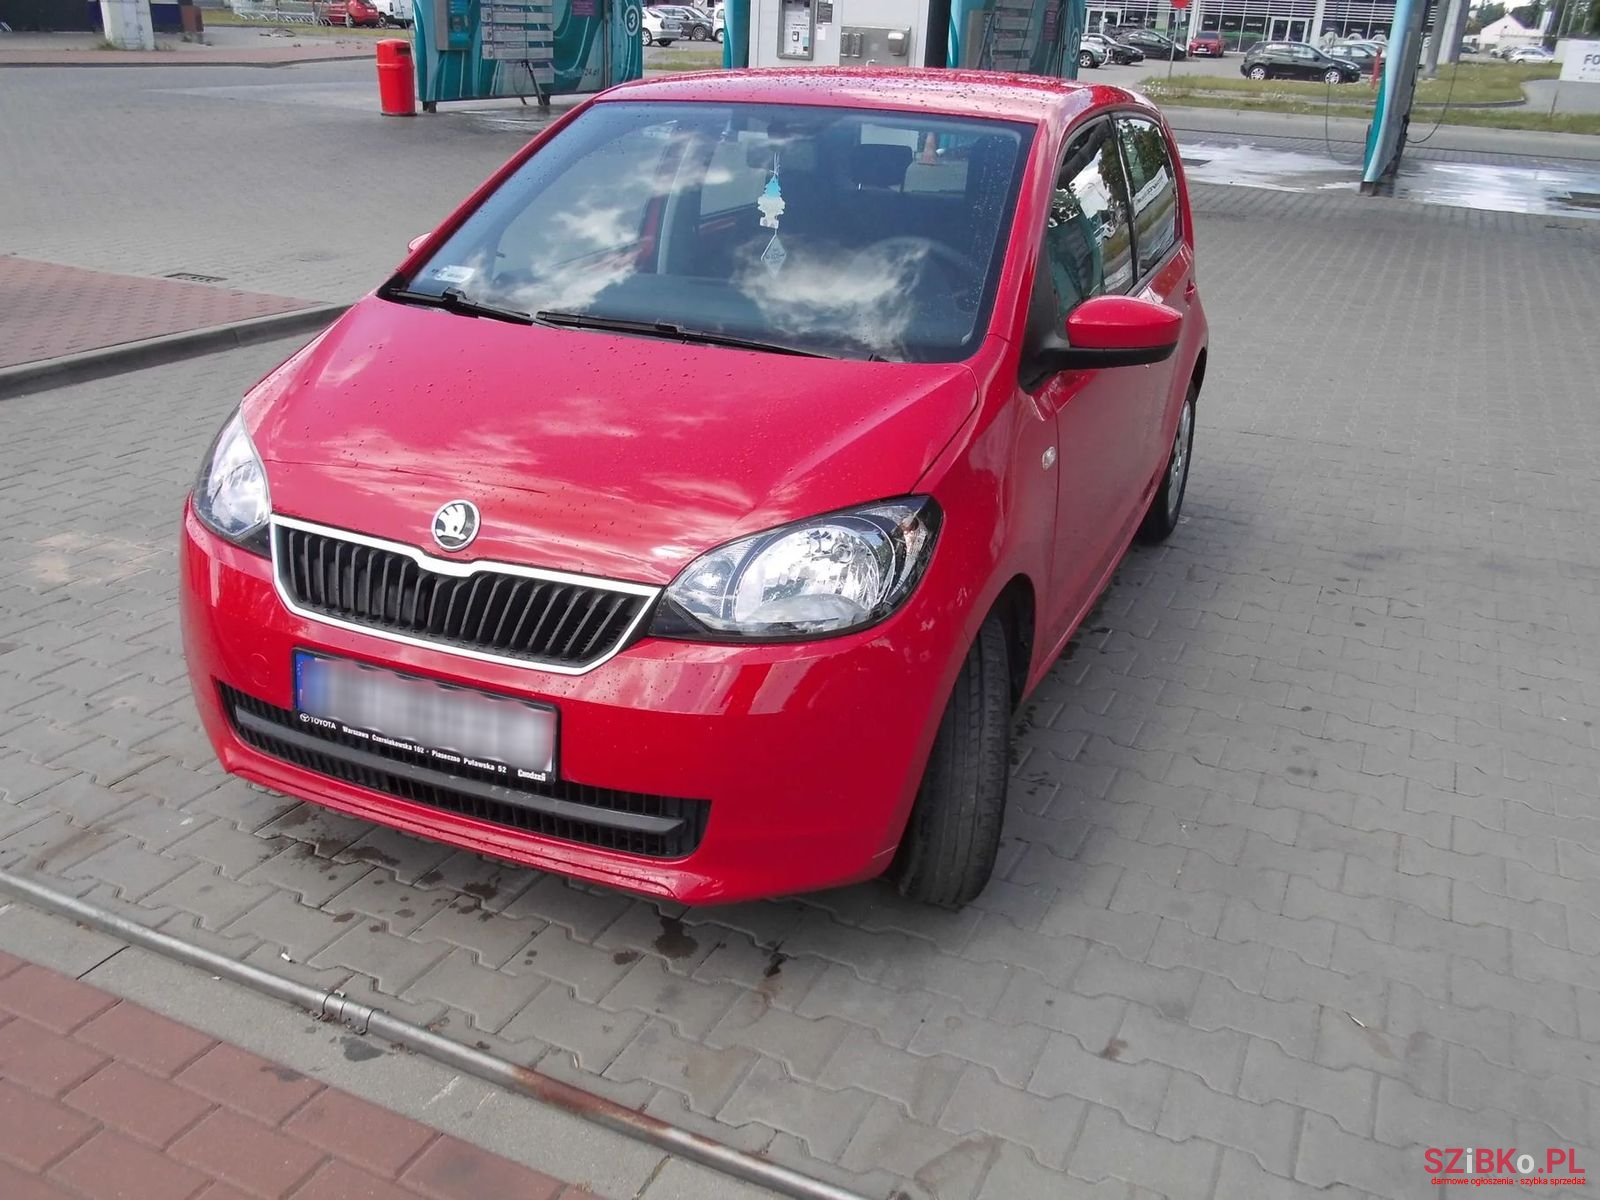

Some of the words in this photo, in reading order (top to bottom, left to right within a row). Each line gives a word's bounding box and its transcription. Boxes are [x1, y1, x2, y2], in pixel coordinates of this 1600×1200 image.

[629, 13, 636, 28] 3
[310, 716, 337, 730] TOYOTA
[342, 725, 369, 739] Warszawa
[372, 734, 412, 751] Czerniakowska
[413, 745, 424, 753] 162
[431, 749, 460, 762] Piaseczno
[497, 765, 507, 773] 52
